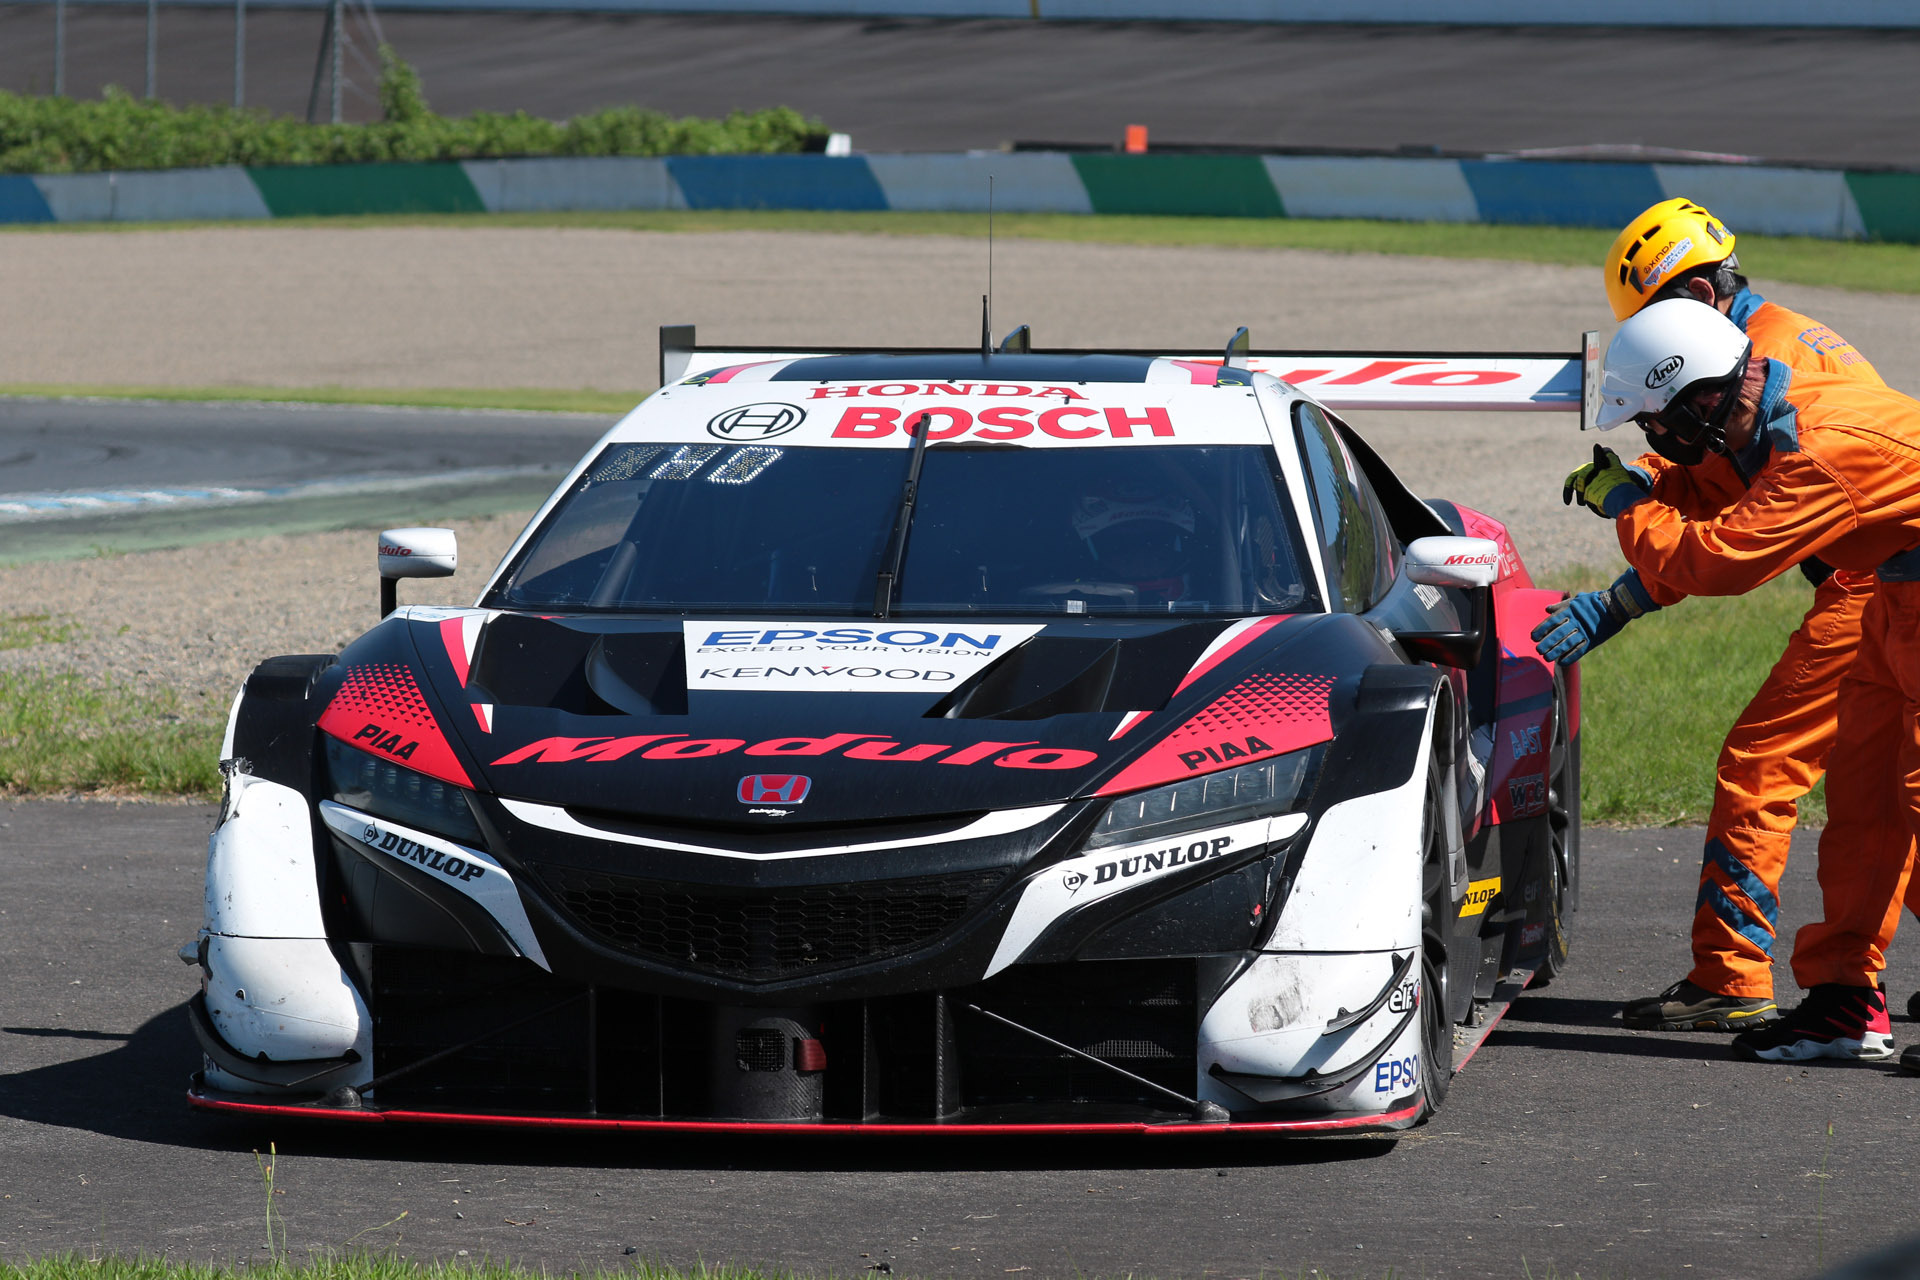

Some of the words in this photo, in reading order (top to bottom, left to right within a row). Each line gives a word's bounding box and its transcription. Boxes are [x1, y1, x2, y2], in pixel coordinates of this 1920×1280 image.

[1651, 357, 1679, 387] Arai
[806, 383, 1088, 400] HONDA
[831, 406, 1176, 440] BOSCH
[1444, 554, 1497, 565] Modulo
[696, 645, 805, 654] EXCEED
[815, 644, 890, 653] YOUR
[901, 646, 992, 658] VISION
[702, 628, 1002, 650] EPSON
[699, 666, 956, 682] KENWOOD
[353, 724, 419, 760] PIAA
[490, 732, 1098, 771] Modulo
[1177, 736, 1274, 771] PIAA
[378, 831, 486, 882] DUNLOP
[1093, 836, 1231, 885] DUNLOP
[1463, 888, 1496, 906] NLOP
[1388, 983, 1414, 1013] elf
[1375, 1054, 1420, 1093] EPSO
